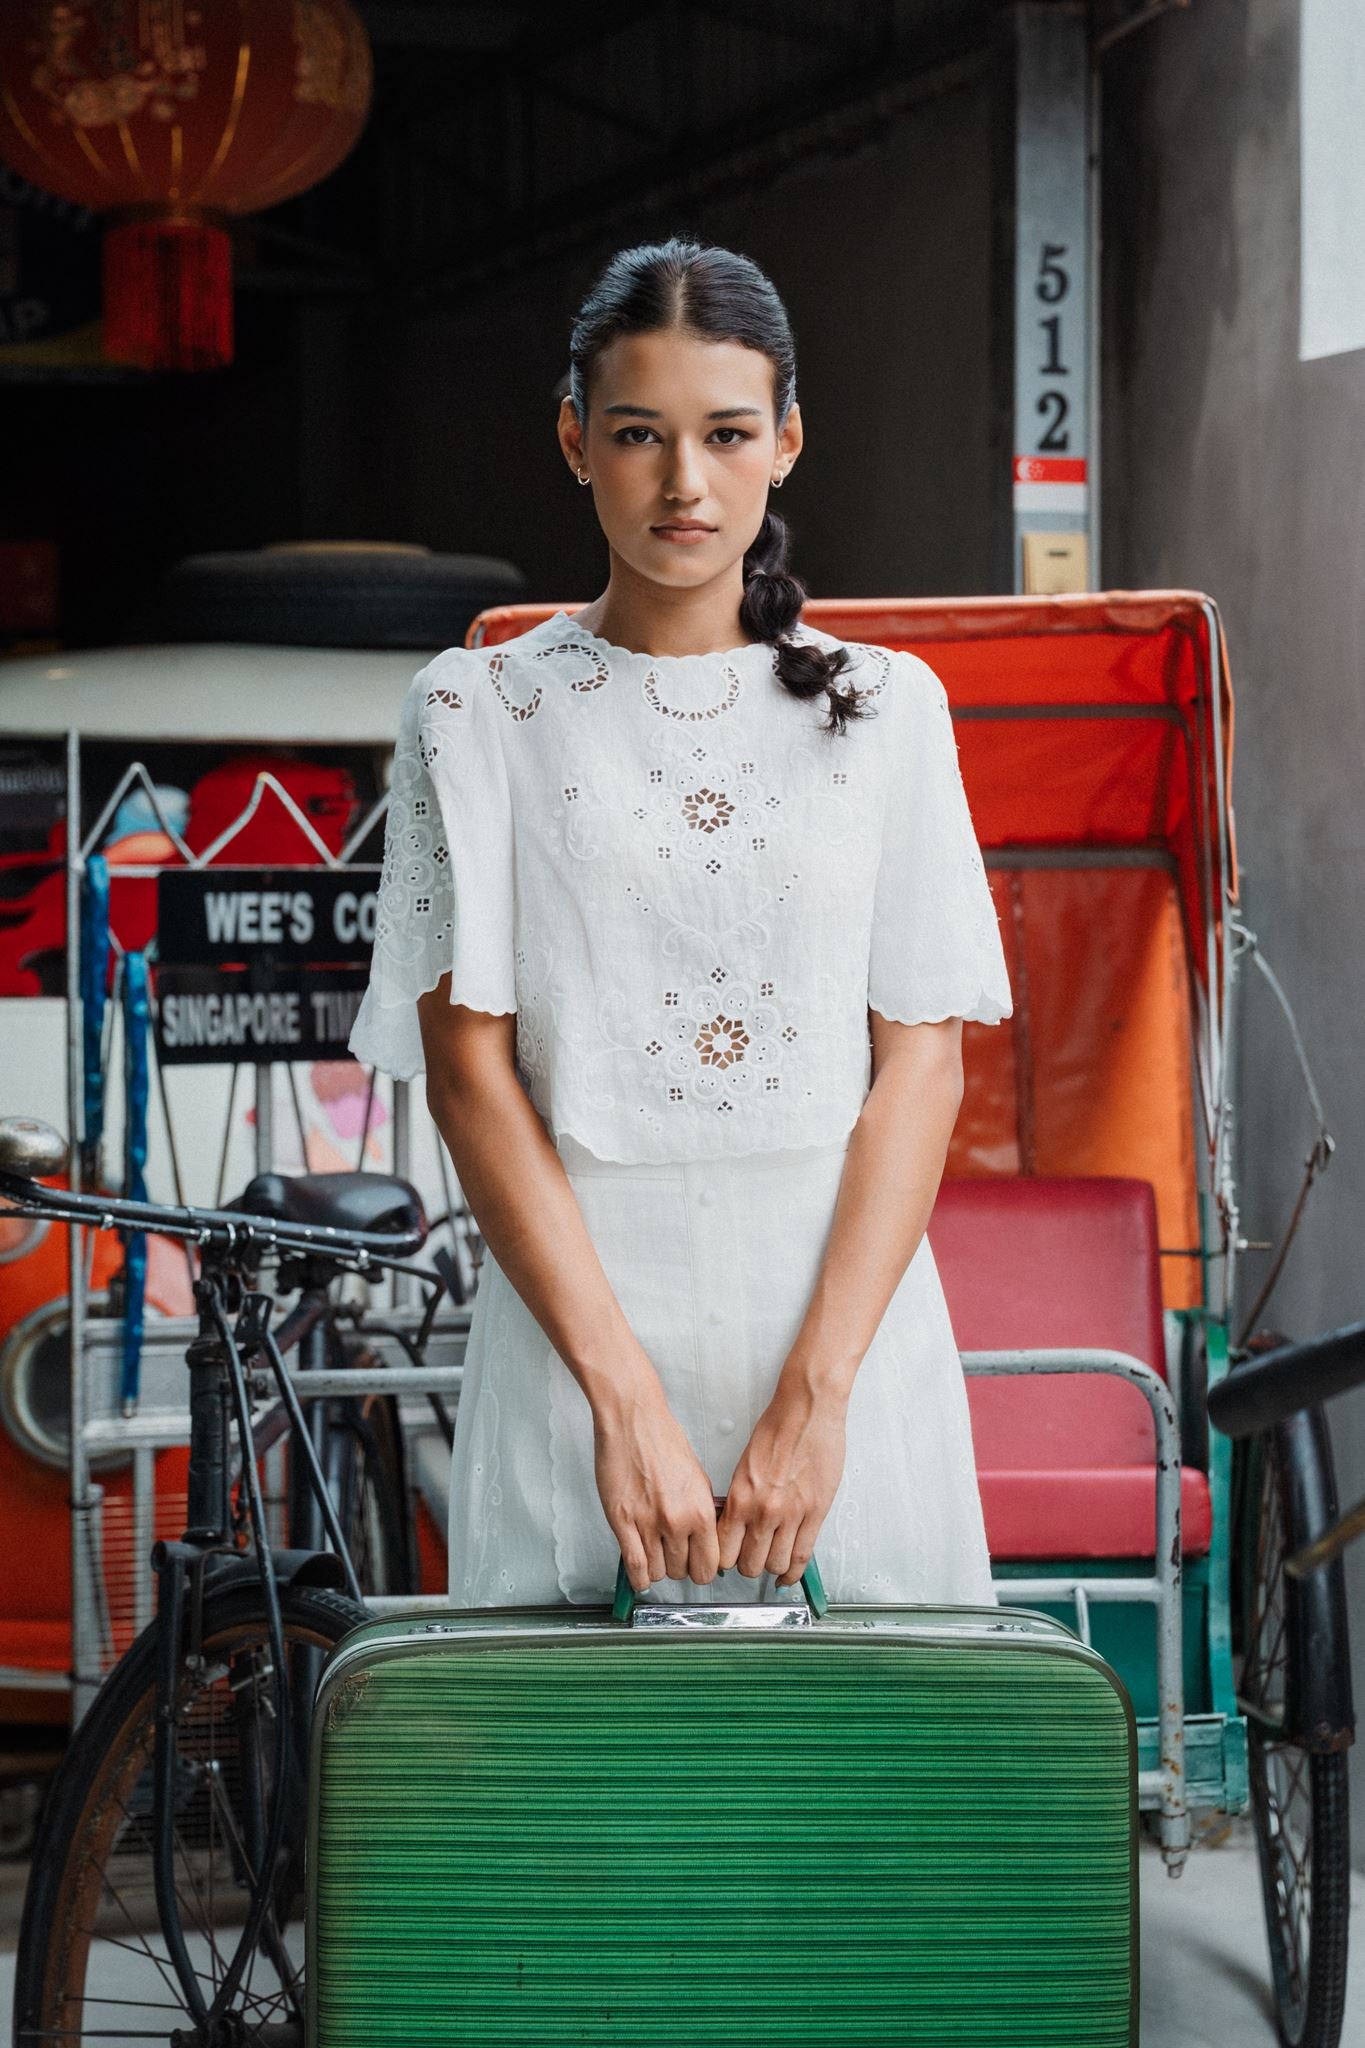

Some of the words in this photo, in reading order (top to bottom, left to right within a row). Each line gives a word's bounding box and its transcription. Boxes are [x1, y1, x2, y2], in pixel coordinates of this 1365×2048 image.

[1036, 242, 1069, 452] 512
[205, 891, 314, 944] WEE'S
[163, 993, 301, 1046] SINGAPORE
